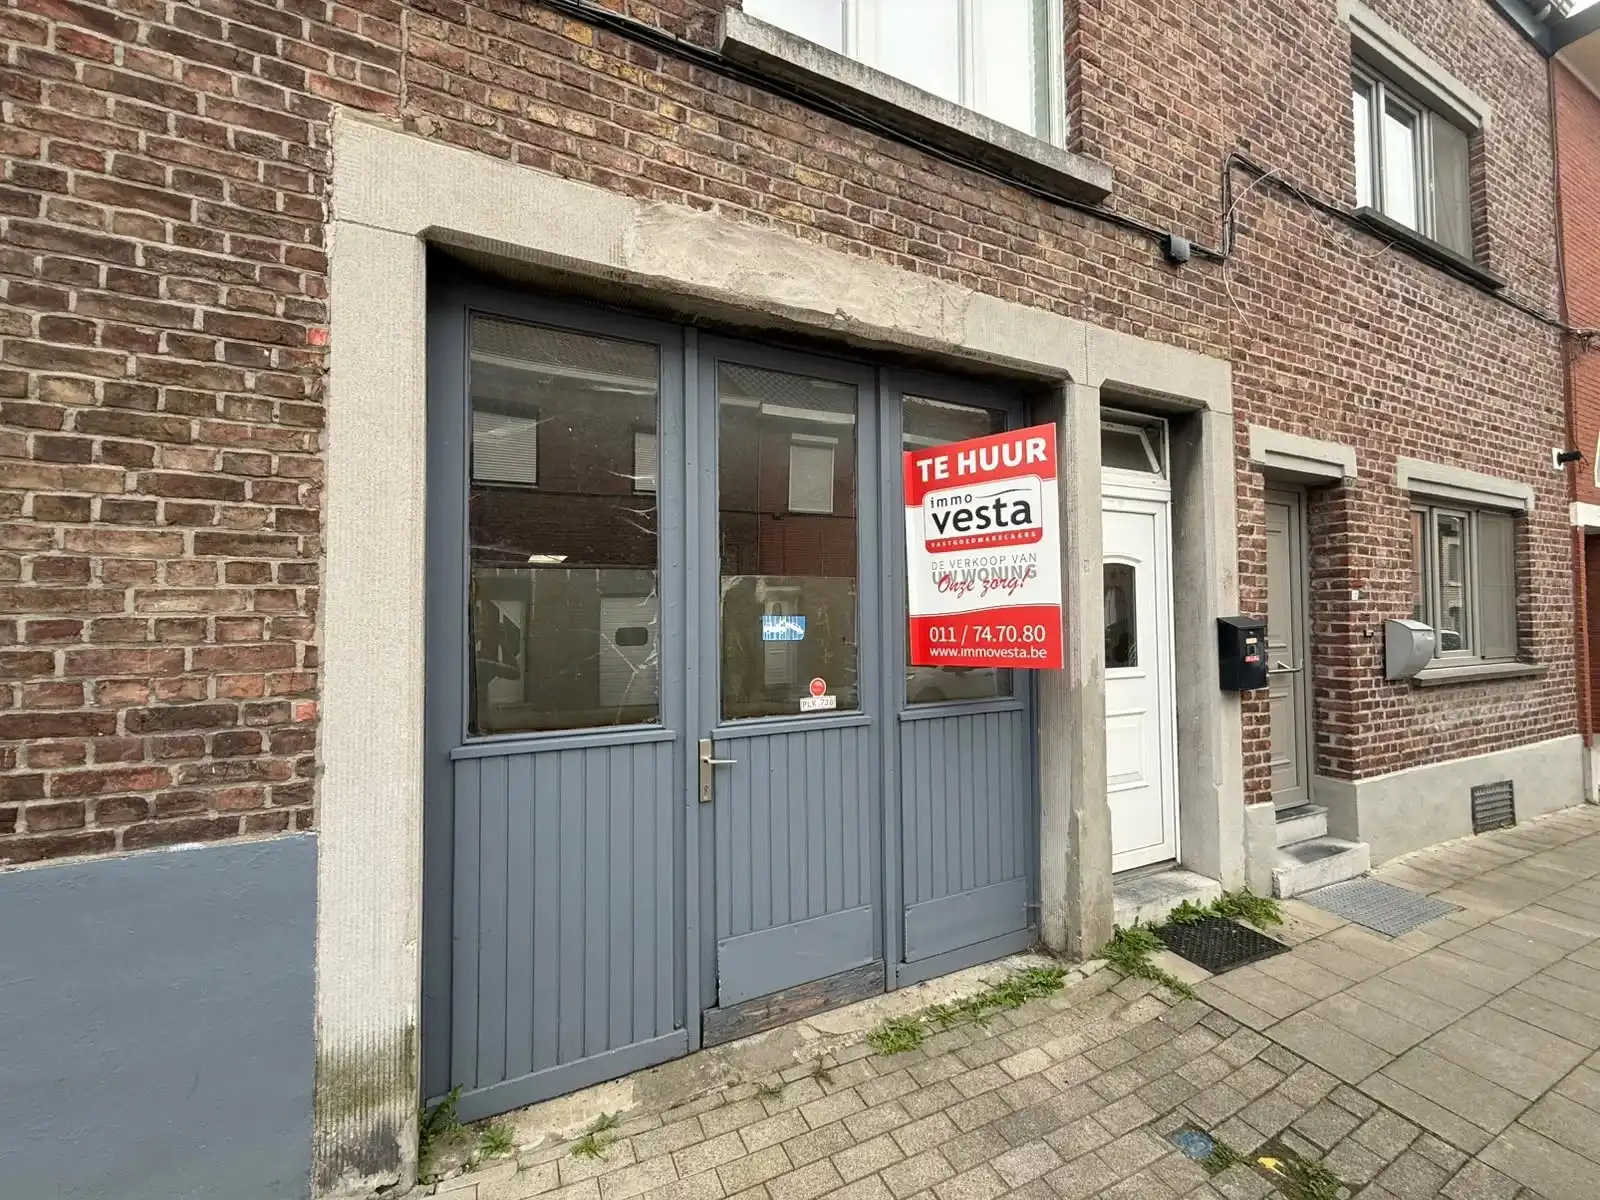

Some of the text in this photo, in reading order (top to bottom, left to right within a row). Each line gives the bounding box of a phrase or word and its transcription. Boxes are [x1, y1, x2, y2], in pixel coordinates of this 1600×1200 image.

[916, 437, 1048, 483] TE HUUR
[930, 493, 973, 509] immo
[931, 497, 1033, 535] vesta
[930, 531, 1036, 548] VASTGOEDMAKELAARS
[931, 552, 1037, 571] DE VERKOOP VAN
[932, 564, 1037, 585] UW WONING
[938, 567, 1031, 599] Onze zorg!
[929, 624, 1046, 646] 011 / 74.70.80
[929, 645, 1047, 659] www.immovesta.be
